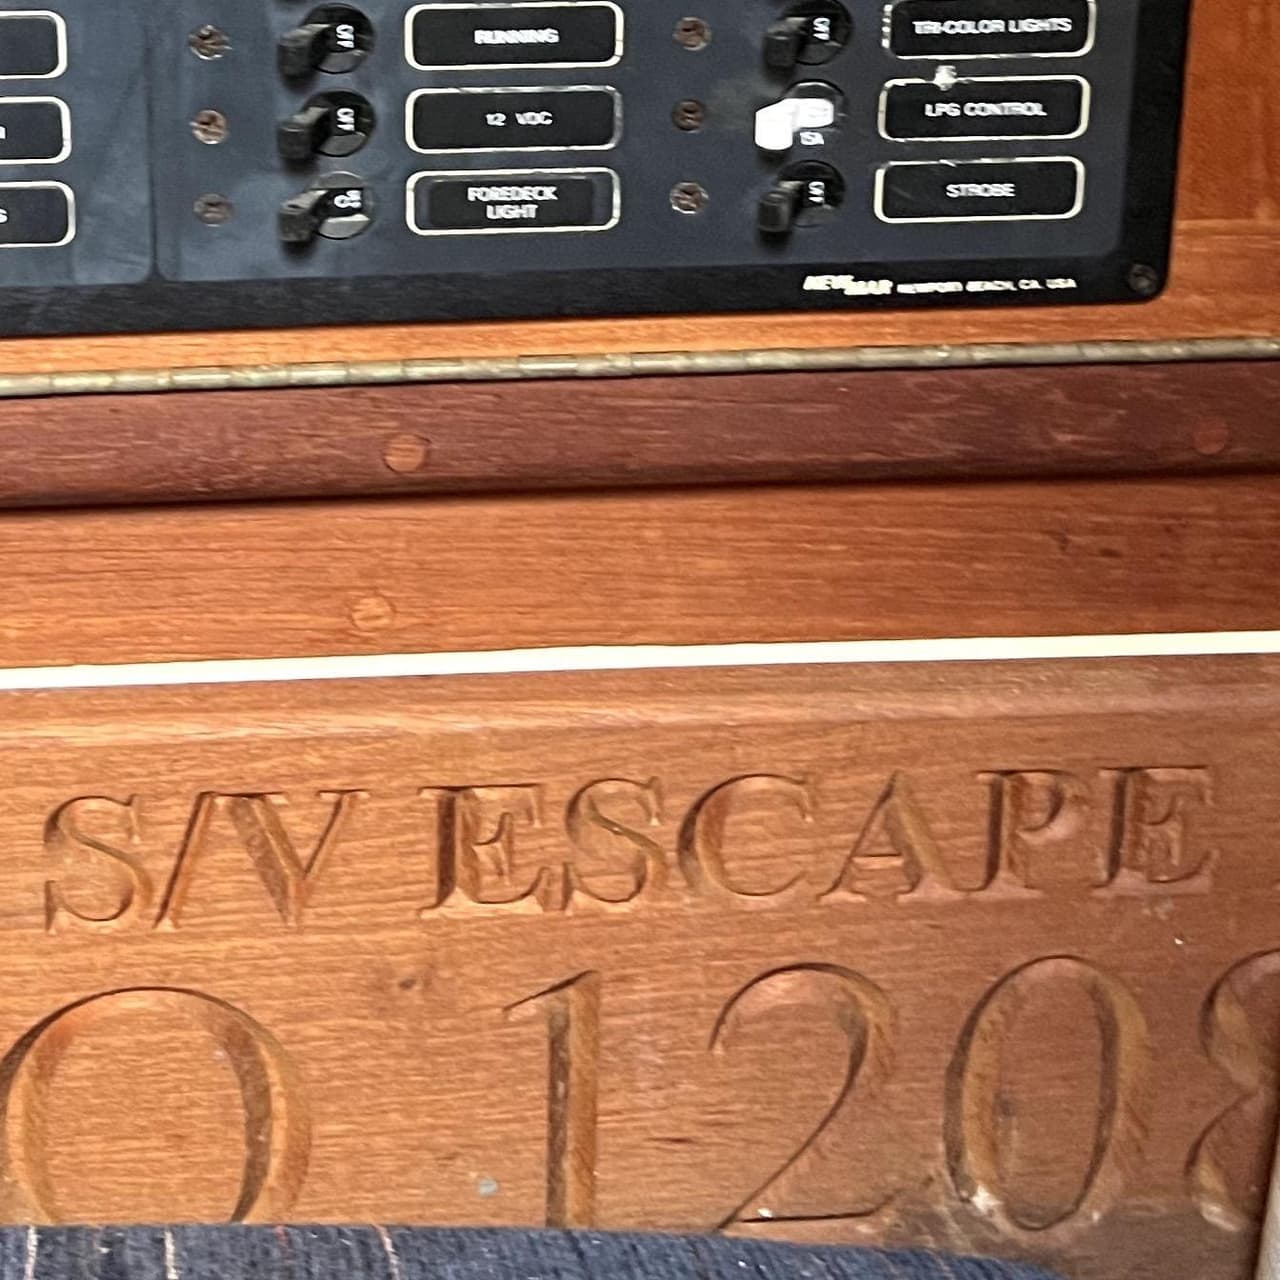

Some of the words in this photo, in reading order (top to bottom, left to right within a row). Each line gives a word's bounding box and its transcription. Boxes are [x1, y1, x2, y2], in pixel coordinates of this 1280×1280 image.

[912, 19, 1005, 35] TRI-COLOR
[1007, 18, 1073, 35] LIGHTS
[474, 28, 560, 45] RUNNING
[925, 103, 960, 118] LPG
[964, 102, 1048, 118] CONTROL
[485, 112, 507, 127] 12
[516, 111, 554, 127] VDC
[467, 186, 559, 203] FOREDECK
[946, 183, 1017, 199] STROBE
[486, 204, 539, 220] LIGHT
[43, 787, 370, 933] S/V
[417, 764, 1213, 922] ESCAPE
